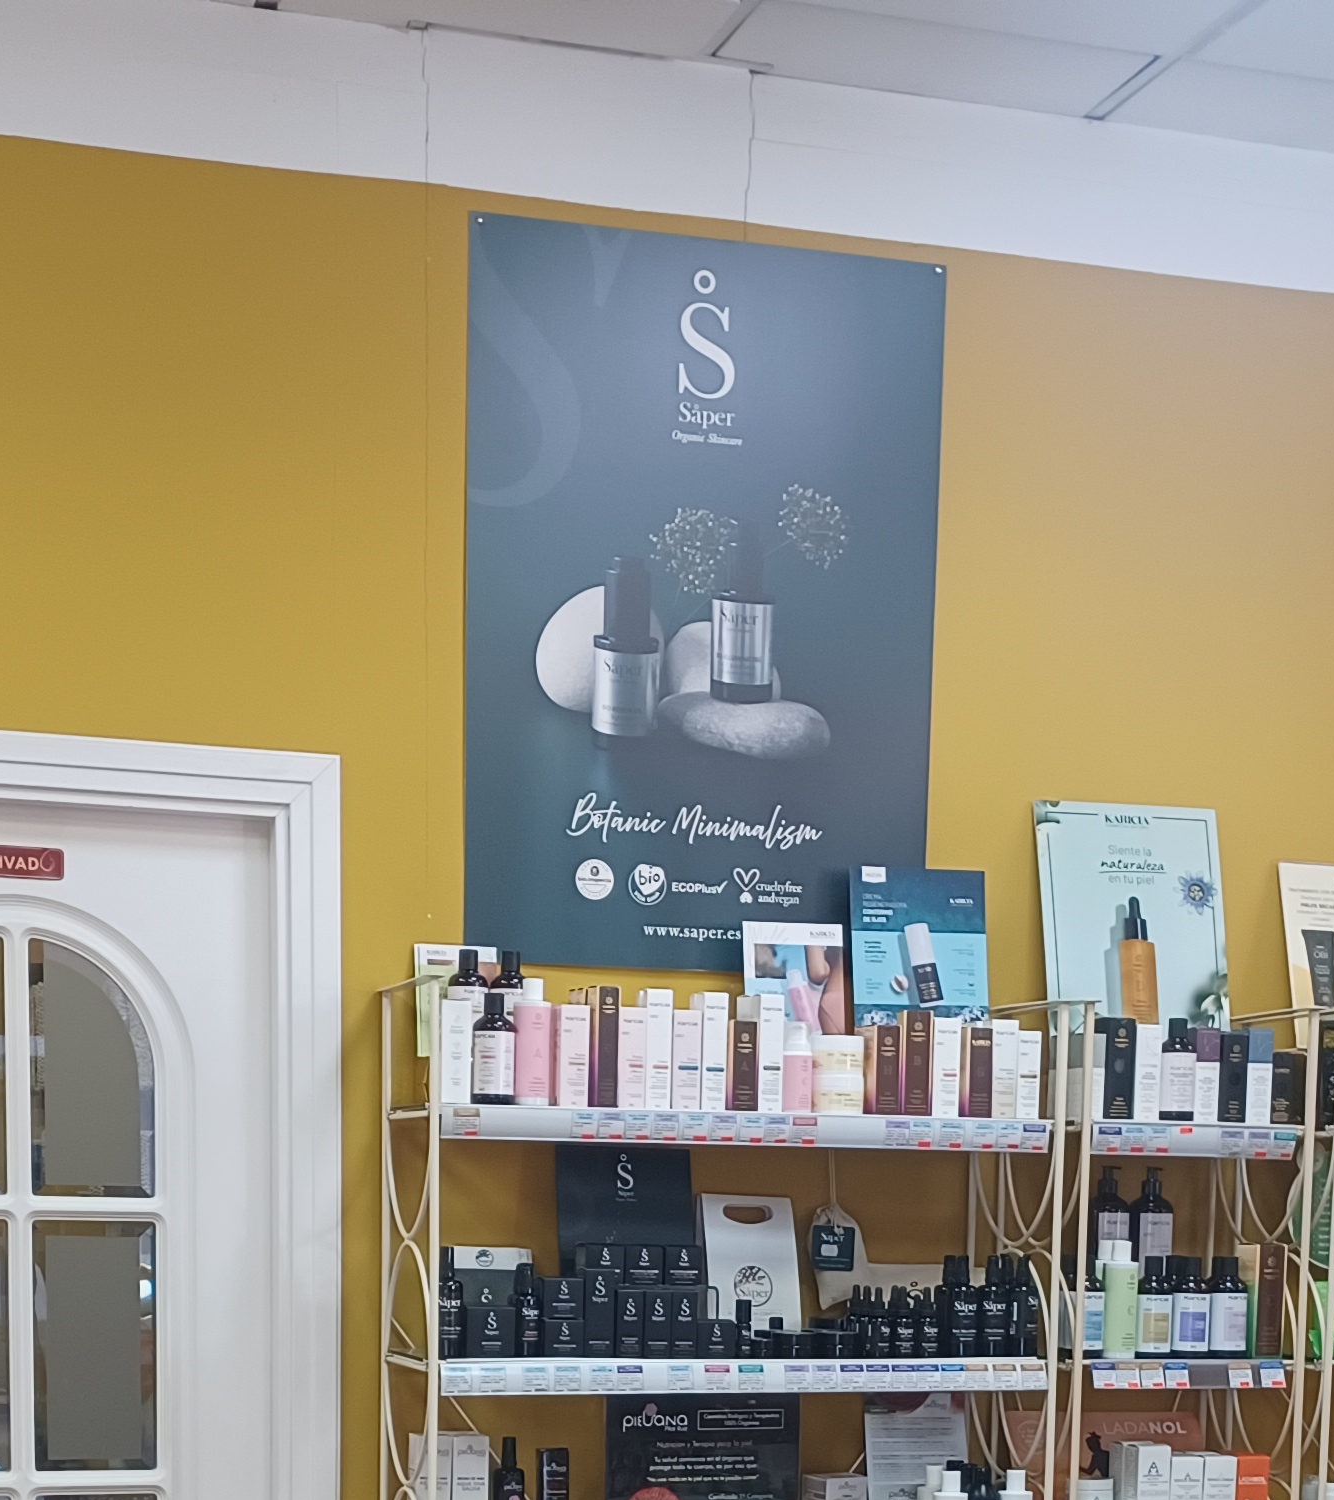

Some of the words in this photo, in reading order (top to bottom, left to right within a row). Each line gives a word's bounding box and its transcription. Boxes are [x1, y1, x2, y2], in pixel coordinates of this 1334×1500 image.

[566, 792, 666, 843] Botanic
[672, 804, 822, 850] Minimalism
[1108, 845, 1139, 856] Siente
[1146, 848, 1152, 857] la
[1100, 860, 1165, 870] naturaleza
[638, 868, 661, 886] bio
[1109, 875, 1121, 883] en
[1124, 875, 1134, 883] tu
[1136, 876, 1155, 885] piel
[643, 924, 741, 942] www.saper.es
[1102, 1421, 1187, 1435] LADANOL
